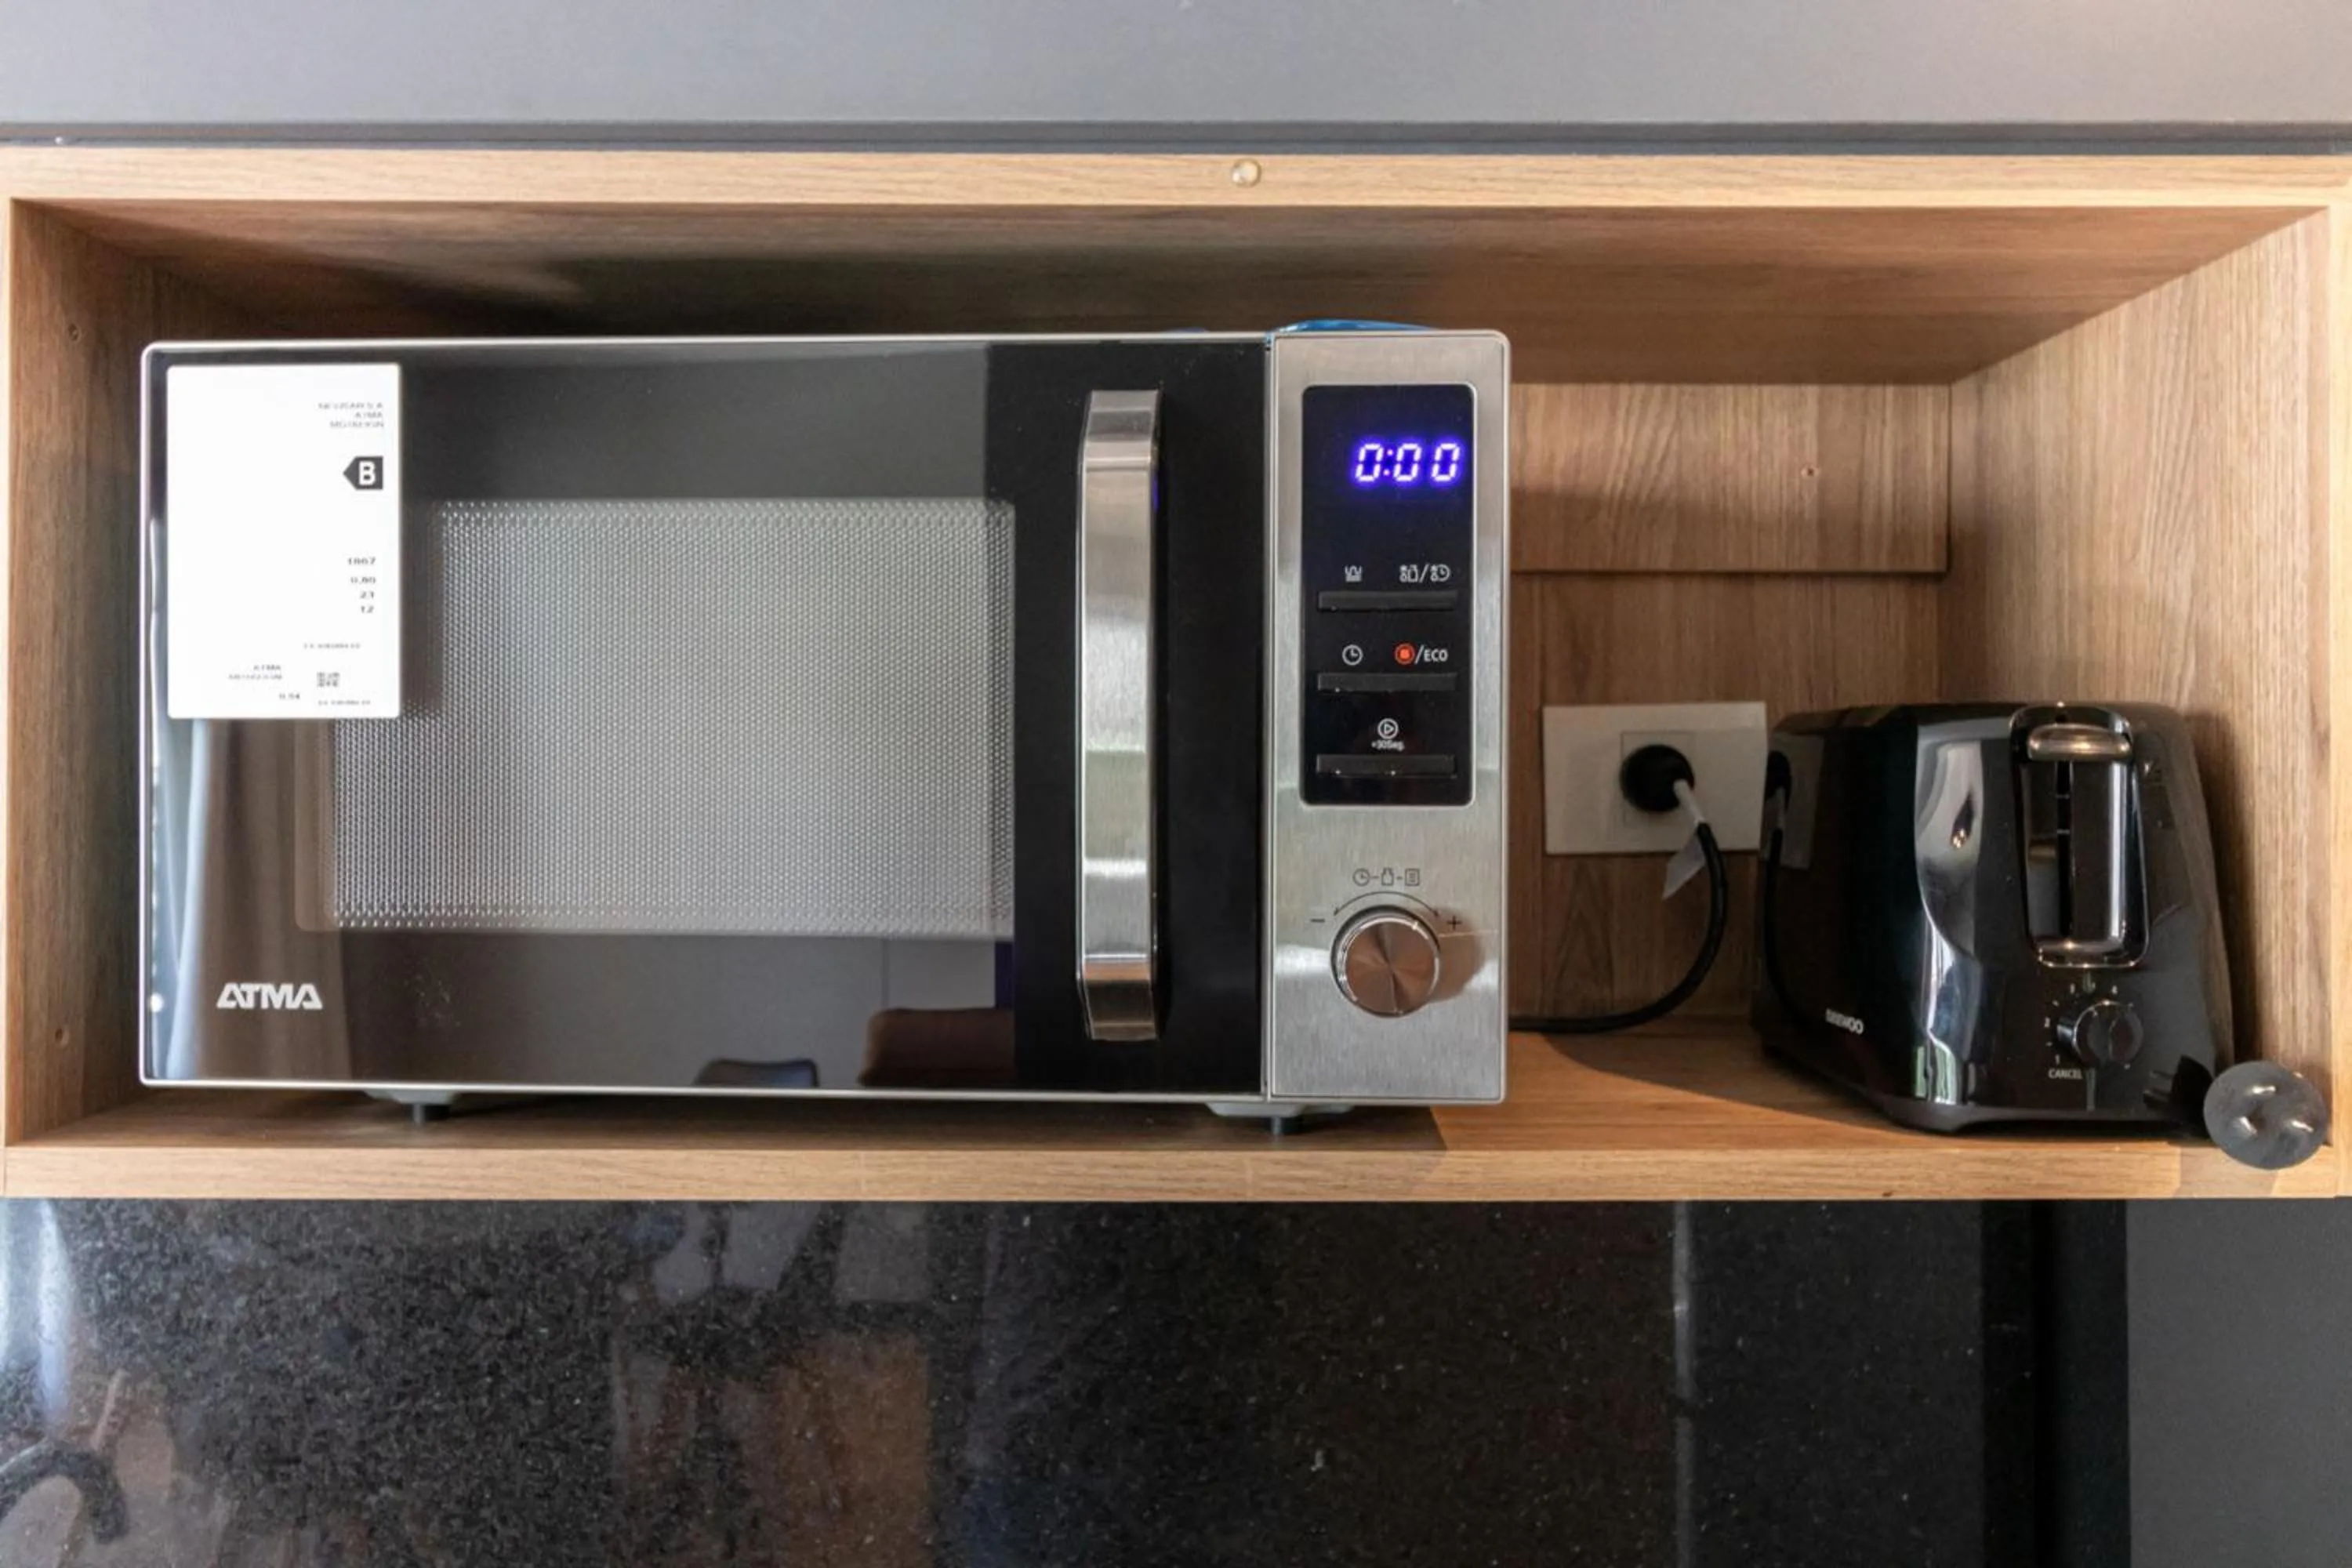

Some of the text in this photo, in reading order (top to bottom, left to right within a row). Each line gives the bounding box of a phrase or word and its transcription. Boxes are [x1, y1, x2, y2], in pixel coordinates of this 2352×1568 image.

[358, 460, 376, 486] B
[216, 982, 324, 1010] ATMA
[2048, 1068, 2083, 1080] CANCEL
